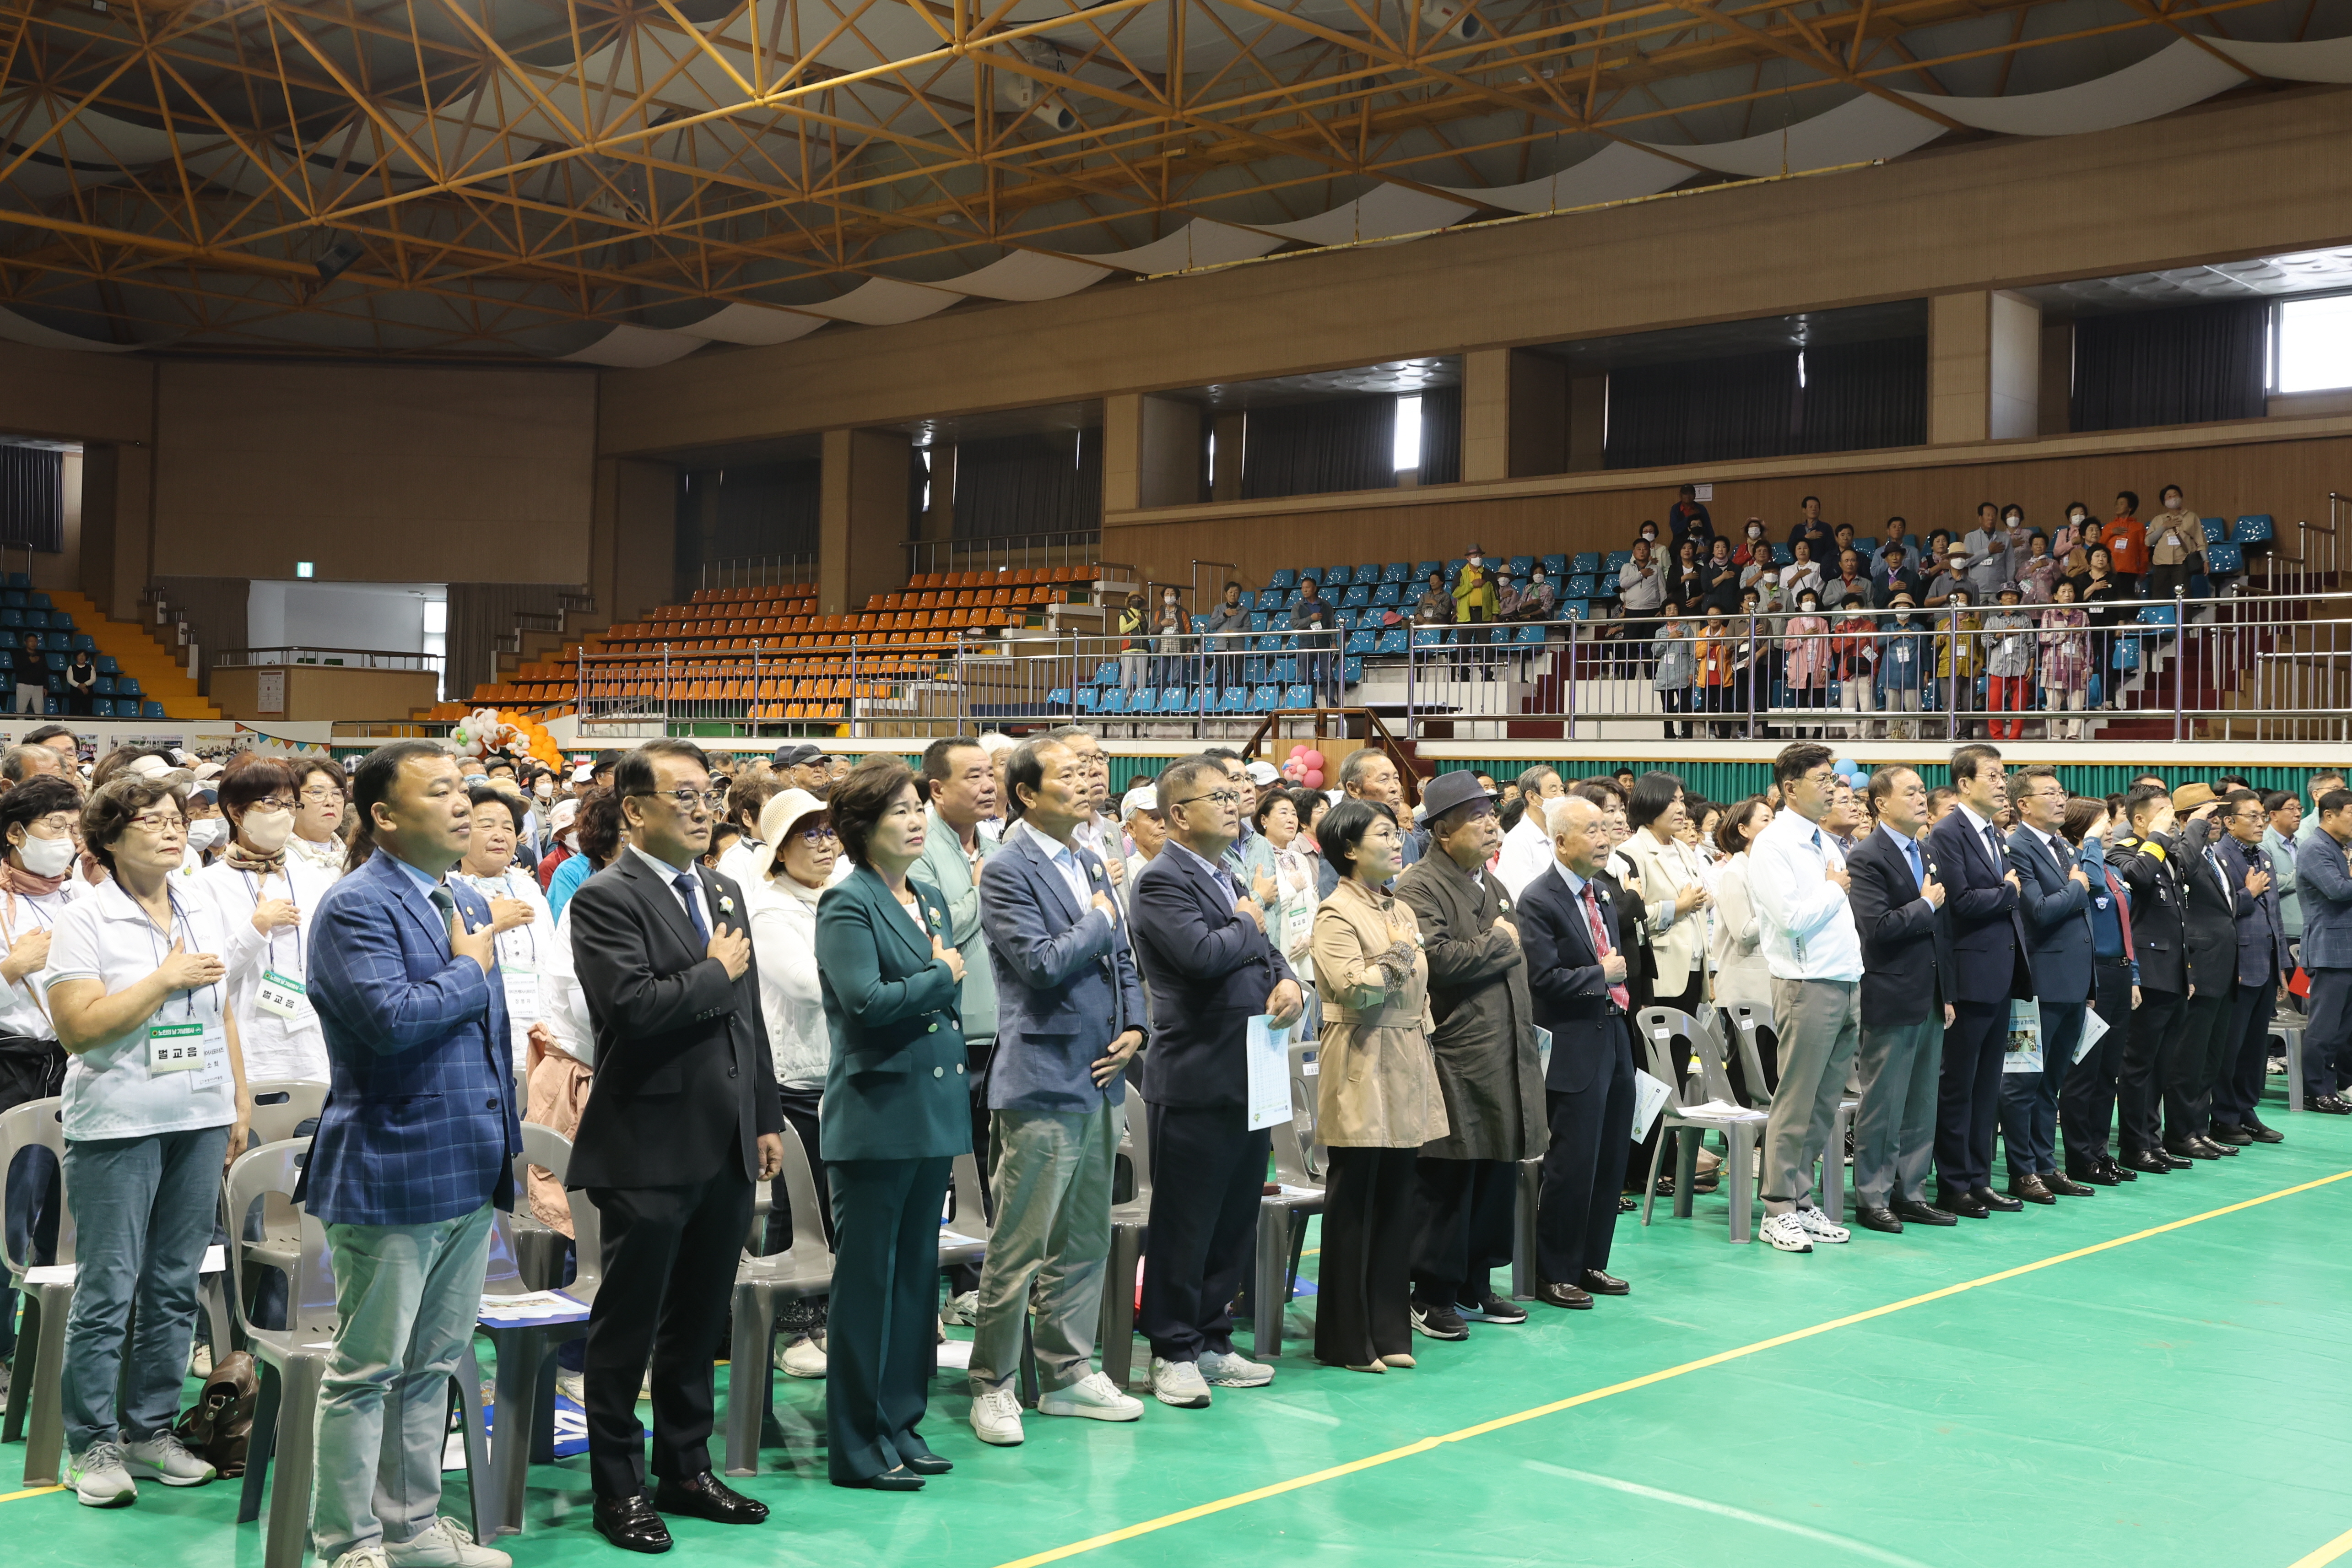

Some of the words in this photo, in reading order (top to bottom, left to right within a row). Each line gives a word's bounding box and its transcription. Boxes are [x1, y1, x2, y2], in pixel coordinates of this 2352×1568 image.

[262, 990, 295, 1009] 벌교읍
[158, 1047, 198, 1060] 벌교읍
[205, 1047, 224, 1056] 어서포터즈
